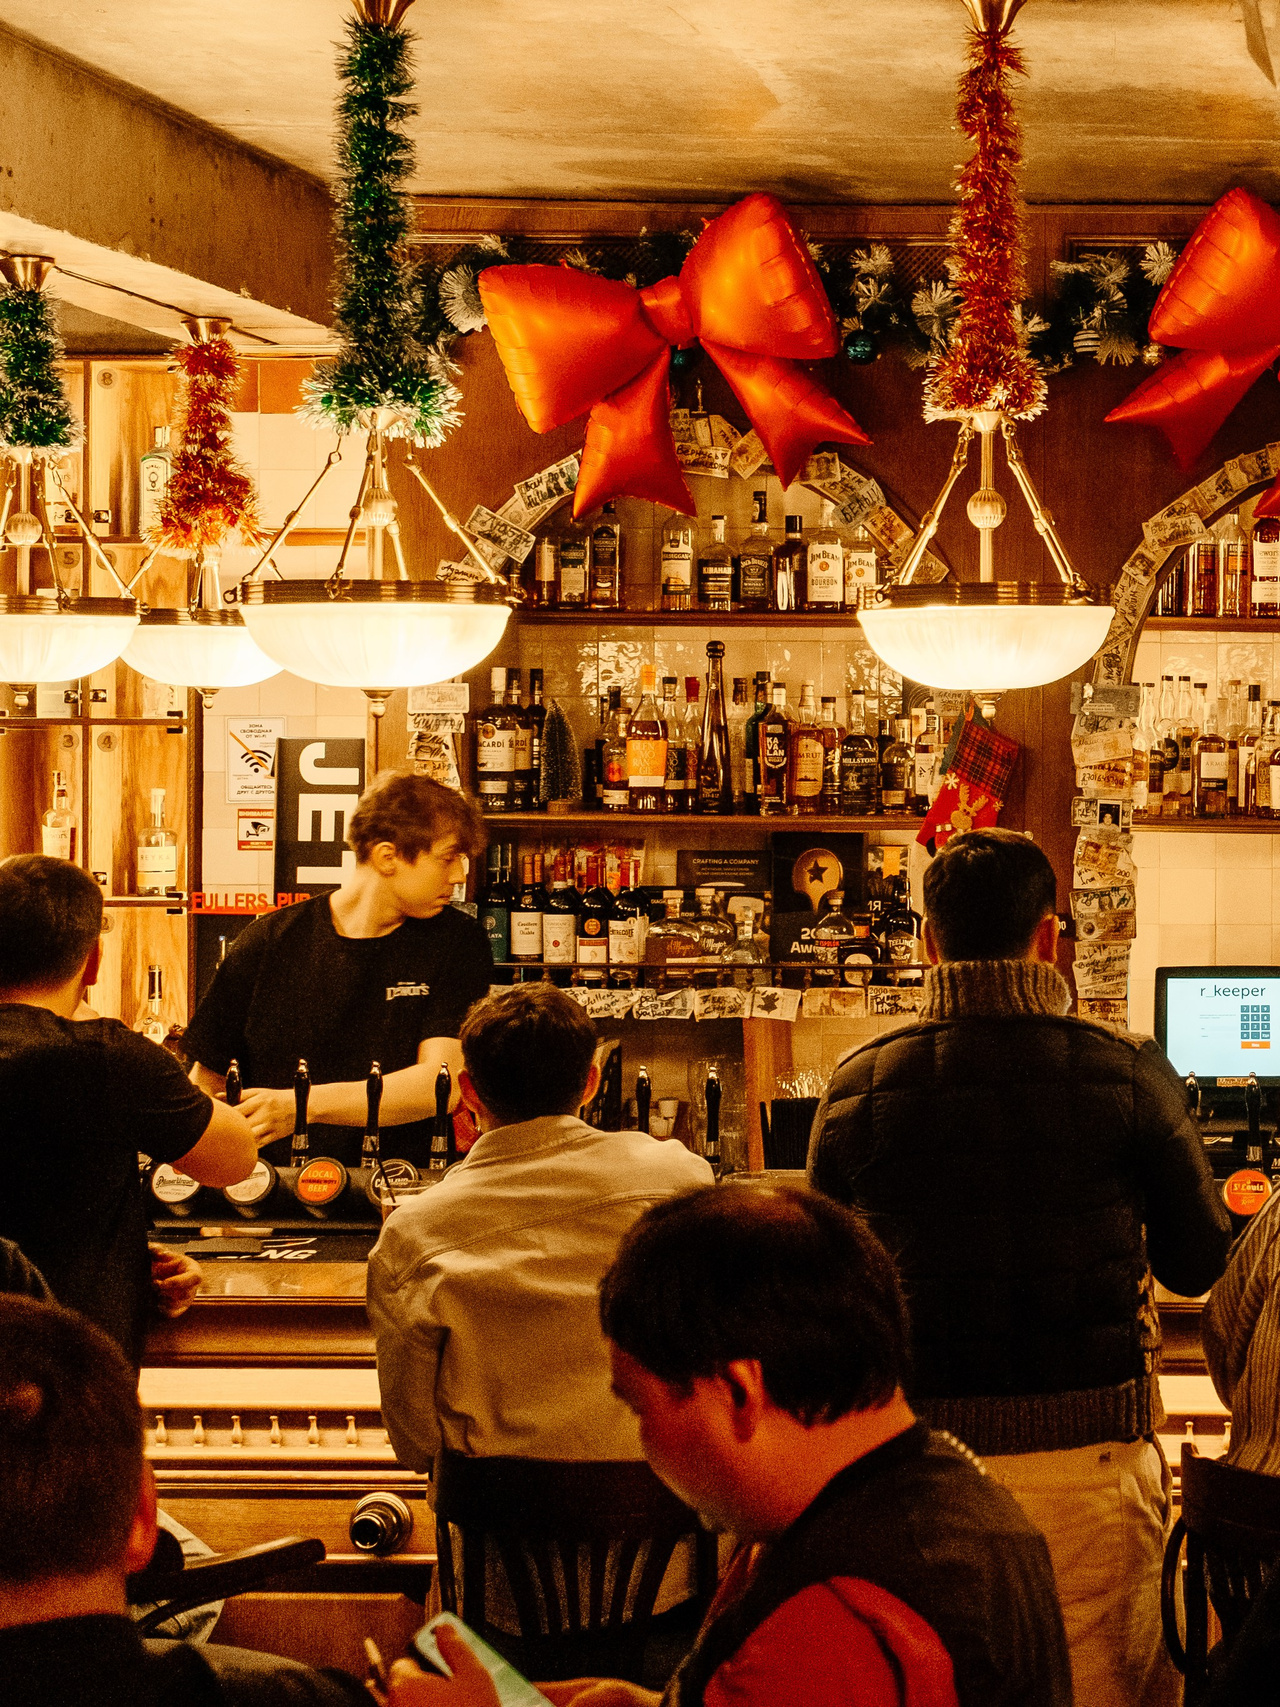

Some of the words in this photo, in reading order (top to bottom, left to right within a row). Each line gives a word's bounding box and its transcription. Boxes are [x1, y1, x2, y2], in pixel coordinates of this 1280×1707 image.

[1227, 460, 1239, 472] 20
[810, 552, 822, 564] JIM
[822, 550, 840, 561] BEAM
[847, 561, 858, 570] JIM
[811, 578, 838, 586] BOURBON
[1127, 701, 1135, 712] 5
[63, 735, 74, 748] 3
[102, 735, 113, 749] 4
[191, 892, 268, 910] FULLERS
[888, 939, 914, 948] TEELING
[1200, 984, 1266, 1000] r_keeper
[308, 1170, 334, 1178] LOCAL
[308, 1184, 328, 1192] BEER
